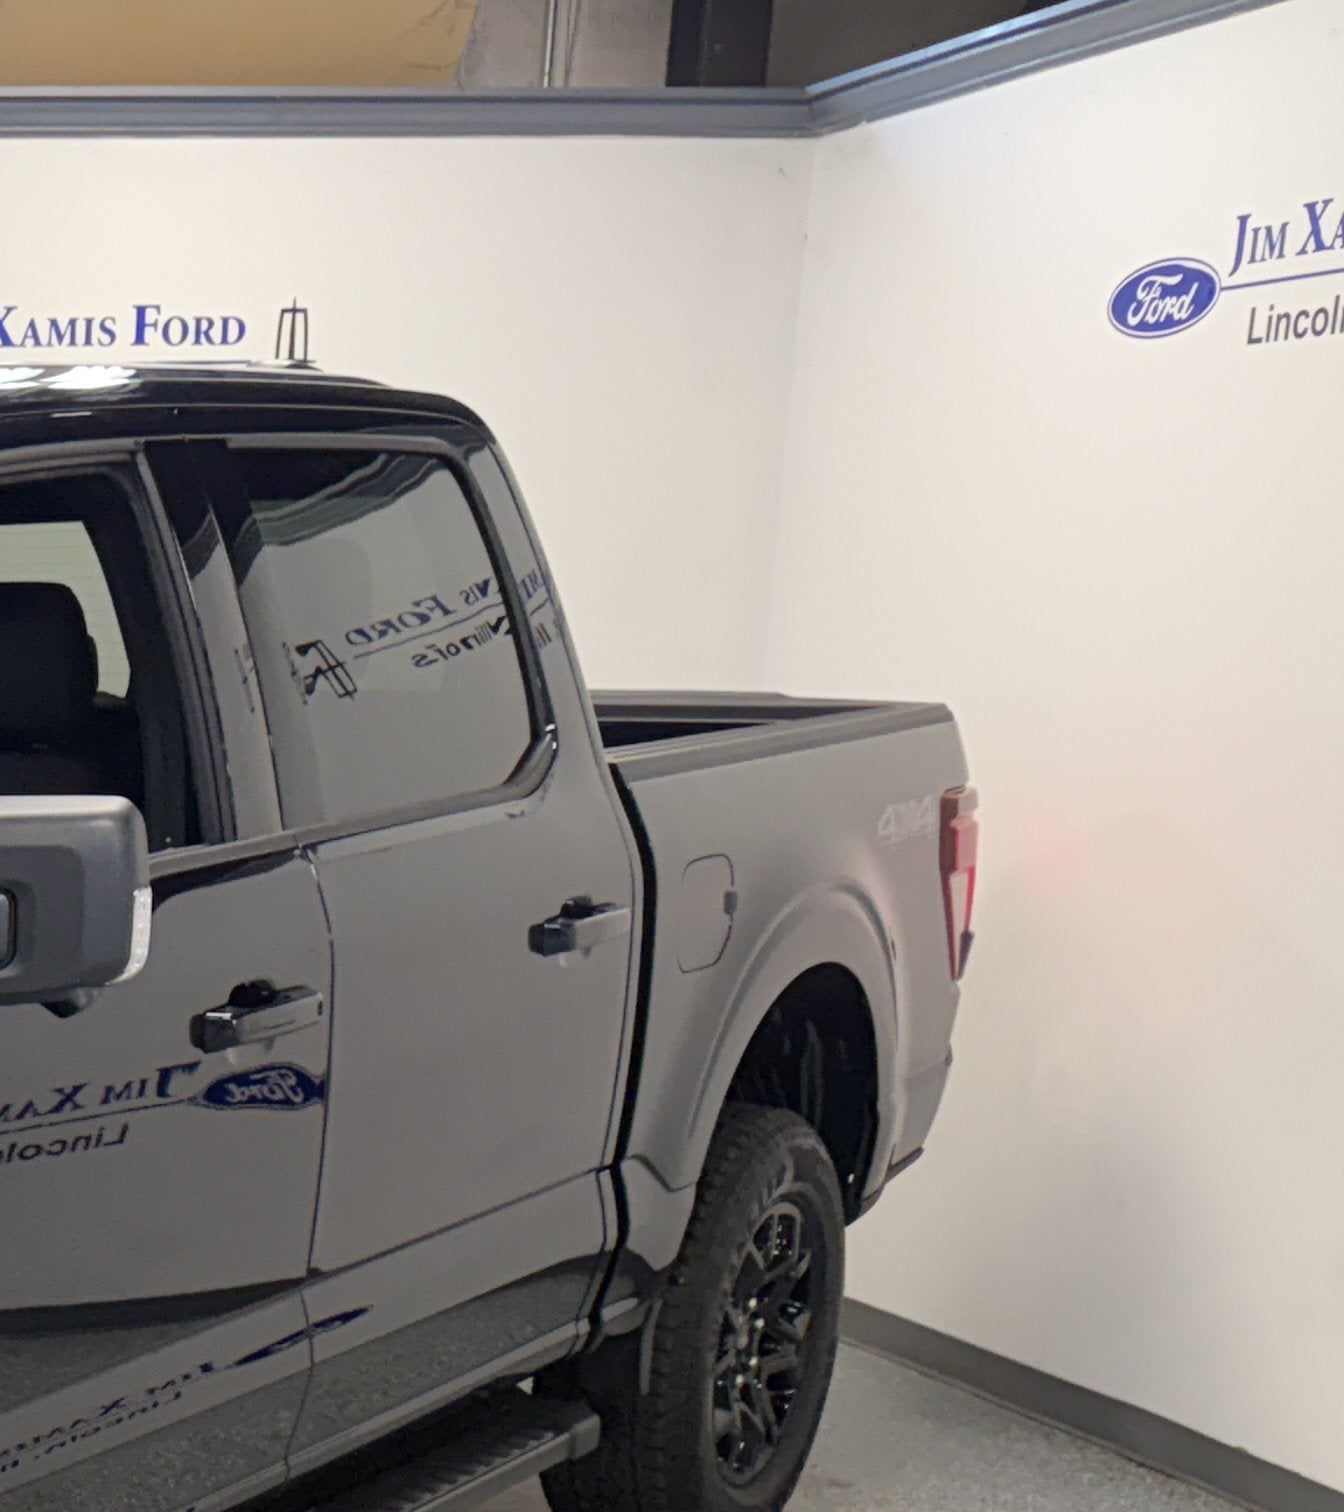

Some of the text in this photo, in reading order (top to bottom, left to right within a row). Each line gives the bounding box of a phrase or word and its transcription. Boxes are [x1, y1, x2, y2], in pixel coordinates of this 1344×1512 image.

[1228, 213, 1290, 277] JIM
[131, 304, 247, 348] FORD
[1127, 273, 1199, 327] Ford
[1246, 294, 1344, 345] Lincol
